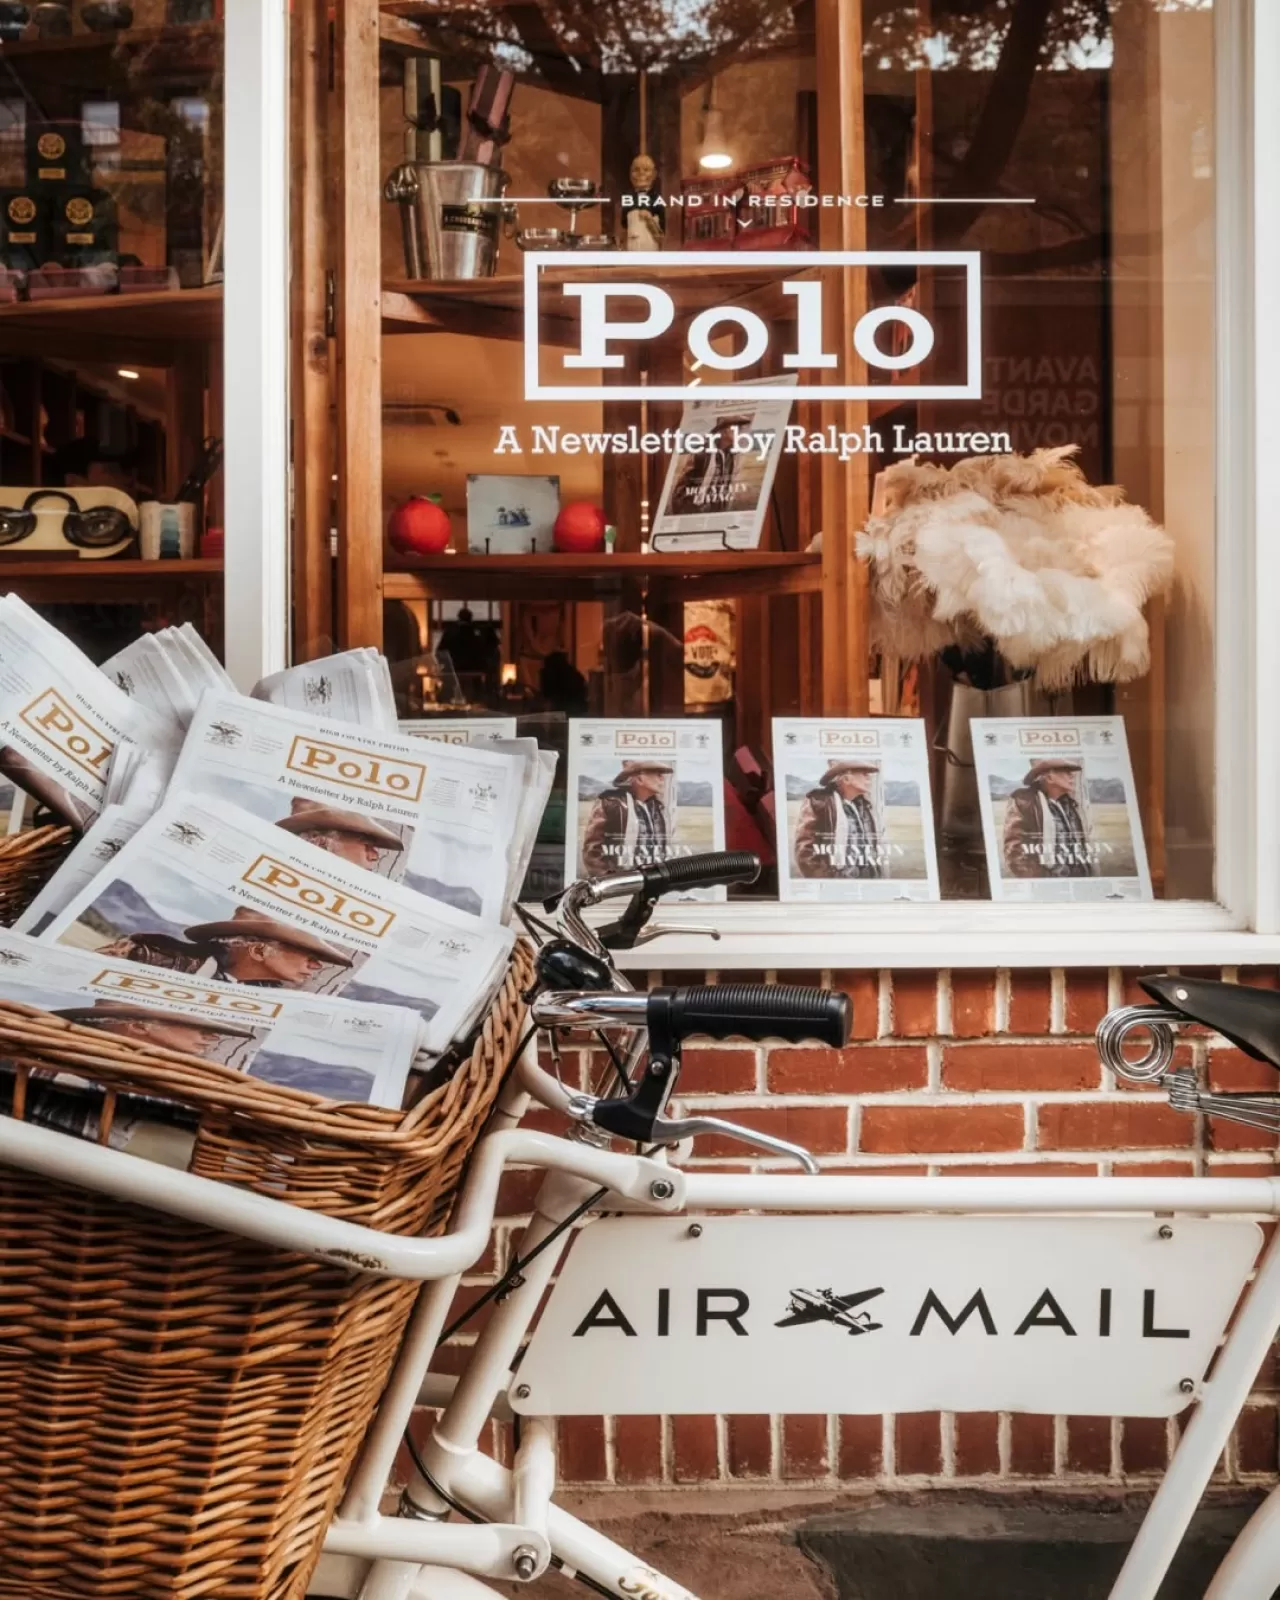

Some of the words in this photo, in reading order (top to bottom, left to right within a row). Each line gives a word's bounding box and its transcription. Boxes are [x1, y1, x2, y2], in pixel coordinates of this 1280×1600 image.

[621, 195, 701, 207] BRAND
[714, 195, 737, 207] IN
[749, 195, 884, 207] RESIDENCE
[563, 281, 935, 371] Polo
[493, 425, 522, 454] A
[531, 425, 721, 454] Newsletter
[730, 425, 776, 462] by
[784, 425, 884, 461] Ralph
[893, 425, 1012, 453] Lauren
[35, 702, 113, 768] Pol
[622, 734, 671, 745] Polo
[826, 732, 874, 744] Polo
[1025, 732, 1074, 743] Polo
[1, 721, 10, 730] A
[8, 728, 53, 763] Newsletter
[52, 760, 66, 772] by
[64, 769, 89, 791] Ralph
[300, 746, 410, 790] Polo
[278, 775, 286, 783] A
[288, 778, 340, 799] Newsletter
[342, 793, 355, 804] by
[357, 797, 384, 811] Ralph
[386, 803, 419, 819] Lauren
[601, 843, 693, 856] MOUNTAIN
[617, 855, 673, 866] LIVIN
[812, 844, 905, 856] MOUNTAIN
[829, 855, 892, 867] LIVING
[1020, 843, 1113, 855] MOUNTAIN
[1038, 854, 1101, 865] LIVING
[259, 865, 376, 927] Polo
[228, 885, 236, 893] A
[237, 889, 294, 918] Newsletter
[295, 912, 309, 924] by
[310, 920, 341, 937] Ralph
[342, 931, 378, 950] Lauren
[111, 976, 261, 1012] Polo
[572, 1288, 750, 1337] AIR
[909, 1287, 1190, 1339] MAIL
